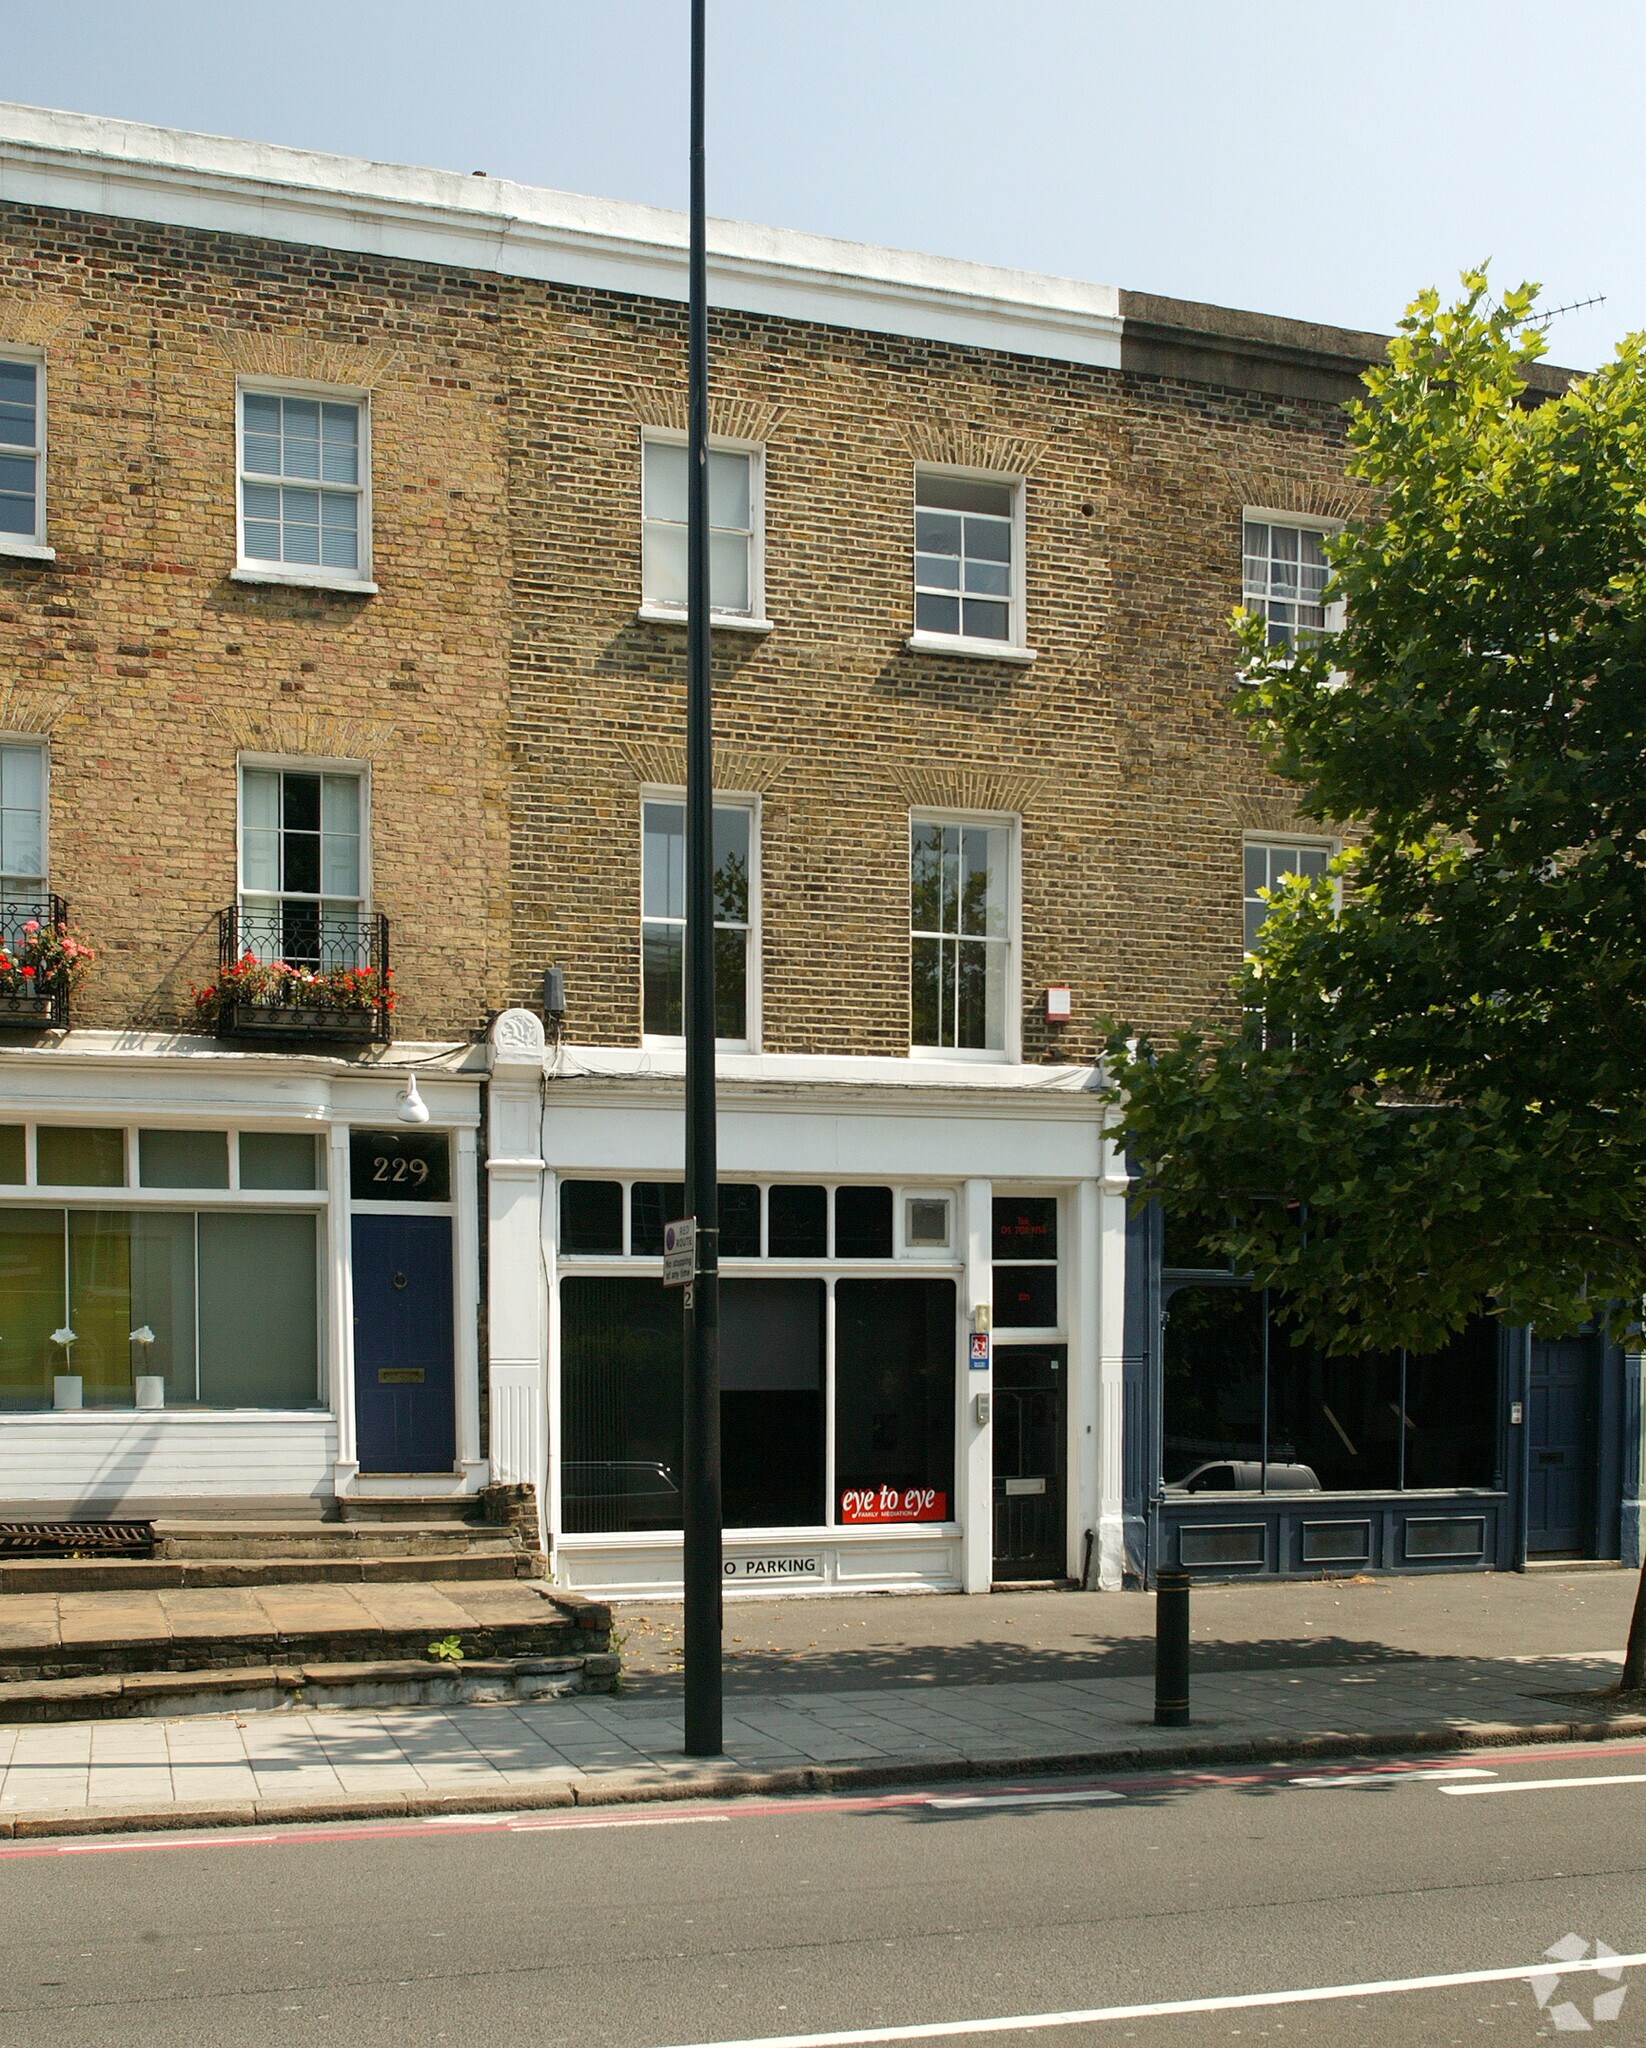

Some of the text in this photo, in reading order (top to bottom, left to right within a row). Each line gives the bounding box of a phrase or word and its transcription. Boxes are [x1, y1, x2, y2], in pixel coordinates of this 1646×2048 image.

[372, 1156, 429, 1187] 229
[680, 1226, 689, 1235] RED
[676, 1236, 692, 1248] ROUTE
[842, 1484, 936, 1519] eye to eye
[724, 1558, 816, 1575] O PARKING
